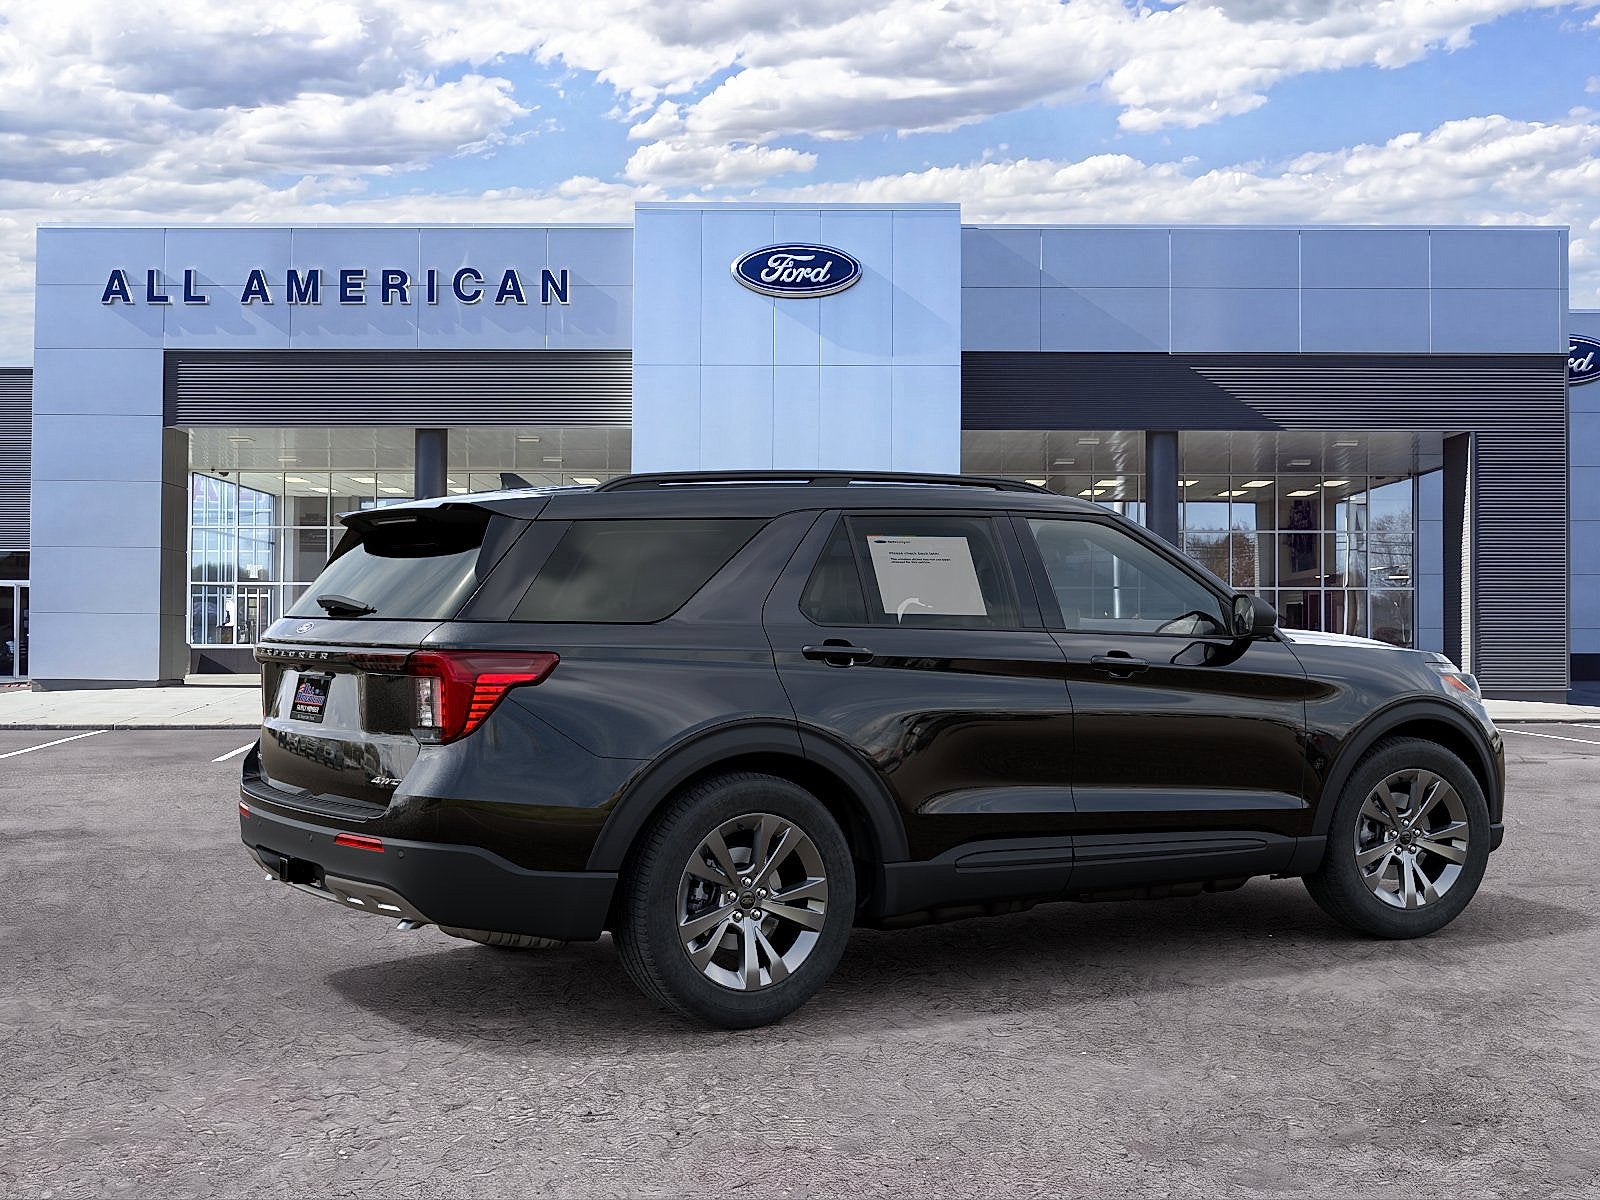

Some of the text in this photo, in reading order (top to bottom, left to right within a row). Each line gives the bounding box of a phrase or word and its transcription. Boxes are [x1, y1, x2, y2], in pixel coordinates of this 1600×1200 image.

[760, 253, 833, 283] Ford
[101, 267, 571, 305] ALL AMERICAN
[260, 648, 329, 660] EXPLORER
